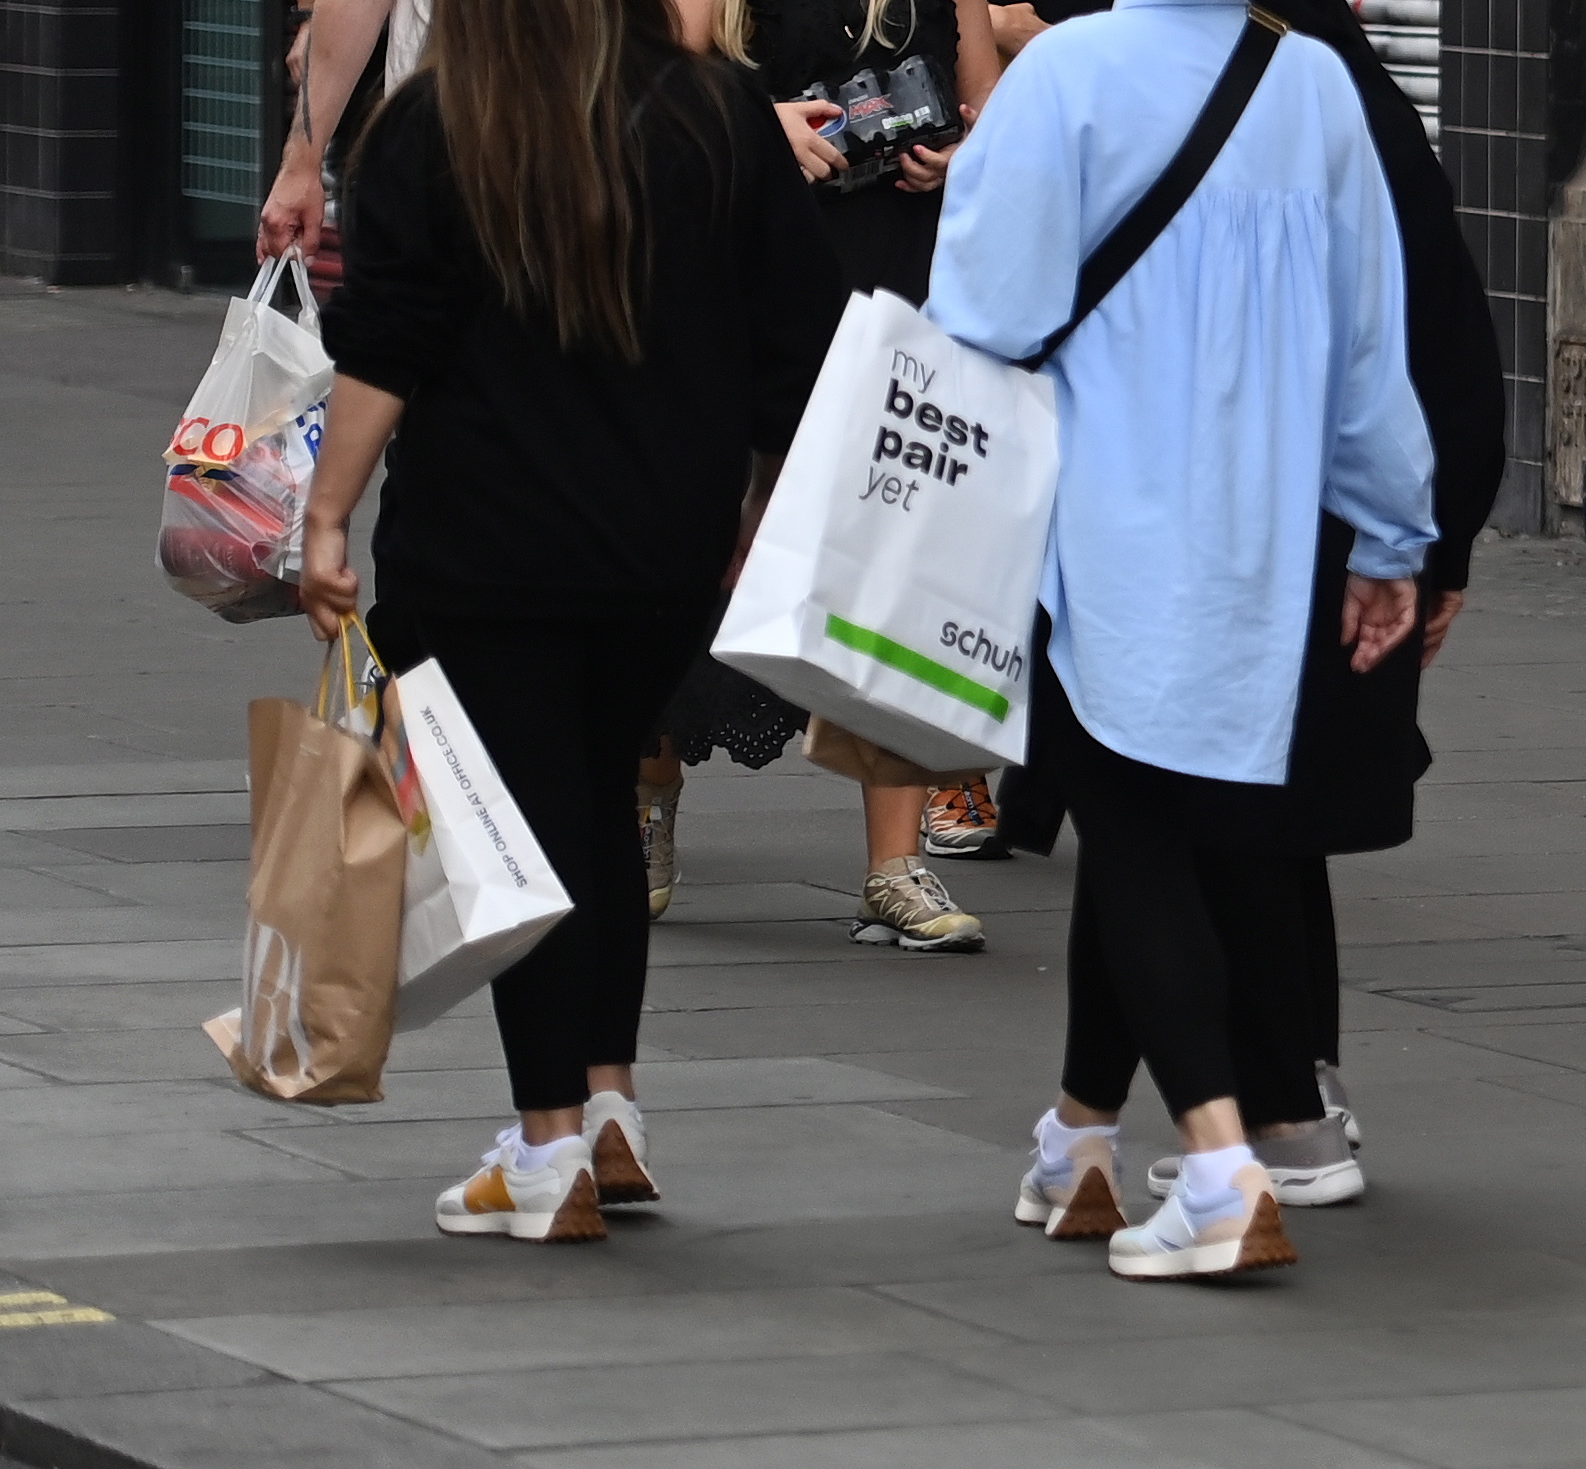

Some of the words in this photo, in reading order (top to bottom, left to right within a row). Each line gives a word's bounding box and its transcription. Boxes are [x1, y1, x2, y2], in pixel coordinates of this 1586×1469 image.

[890, 346, 937, 393] my
[883, 378, 990, 460] best
[872, 424, 970, 488] pair
[859, 466, 920, 514] yet
[939, 620, 1023, 683] schuh
[419, 705, 473, 791] OFFICE.CO.UK
[465, 790, 481, 807] AT
[475, 805, 507, 853] ONLINE
[501, 853, 528, 889] SHOP
